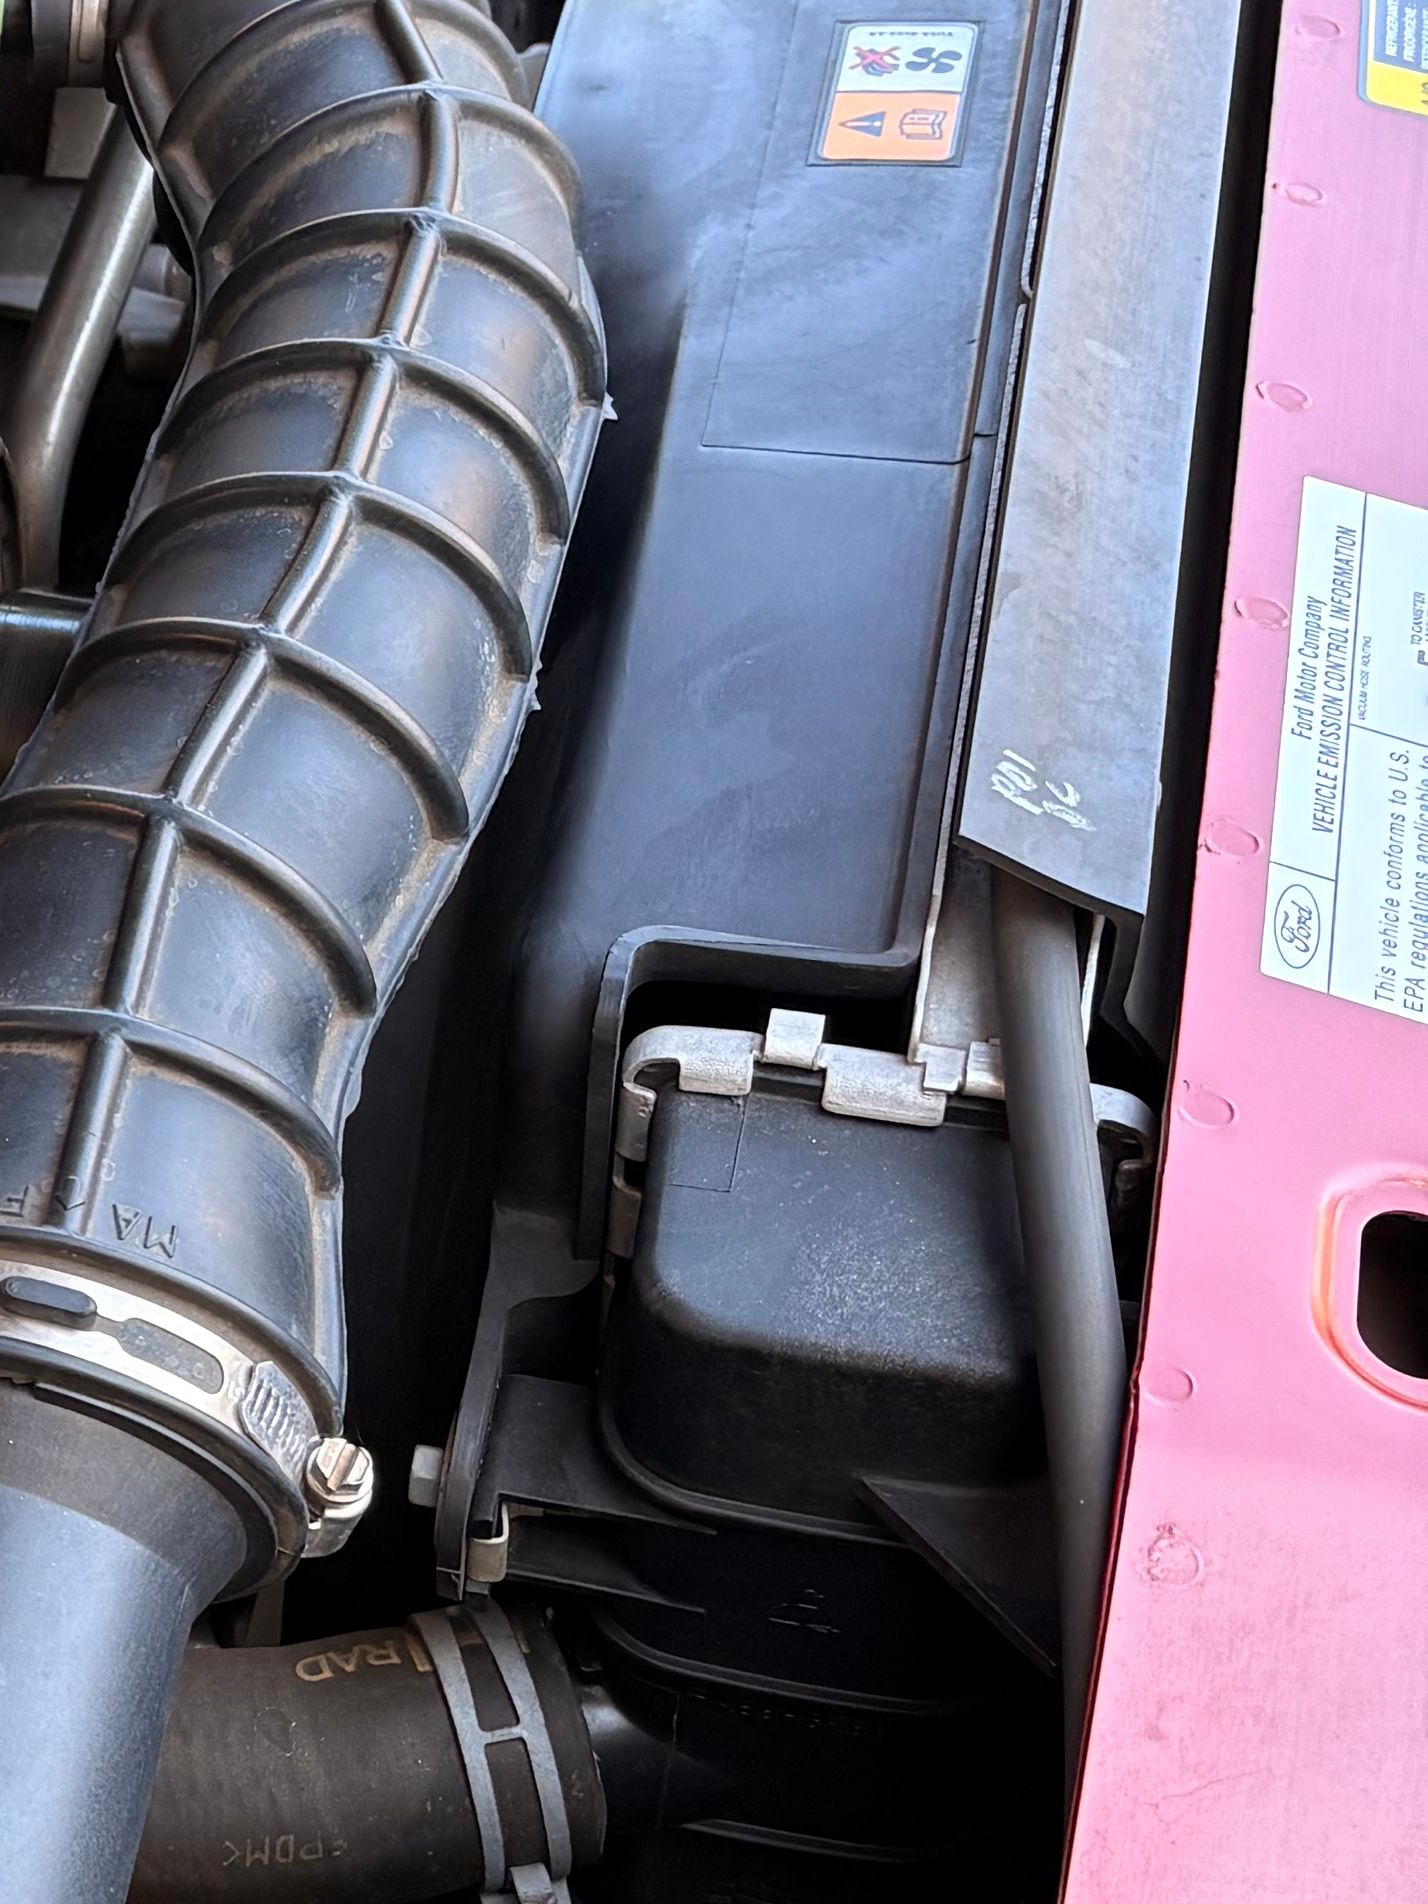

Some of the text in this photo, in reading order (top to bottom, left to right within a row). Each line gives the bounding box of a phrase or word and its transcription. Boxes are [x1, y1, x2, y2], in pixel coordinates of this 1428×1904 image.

[1291, 595, 1328, 740] Ford Motor Company
[1312, 524, 1358, 834] VEHICLE EMISSION CONTROL INFORMATION
[1280, 900, 1314, 953] Ford
[1374, 749, 1410, 1002] This vehicle conforms to U.S.
[1407, 871, 1428, 970] regulations
[1404, 977, 1425, 1013] EPA
